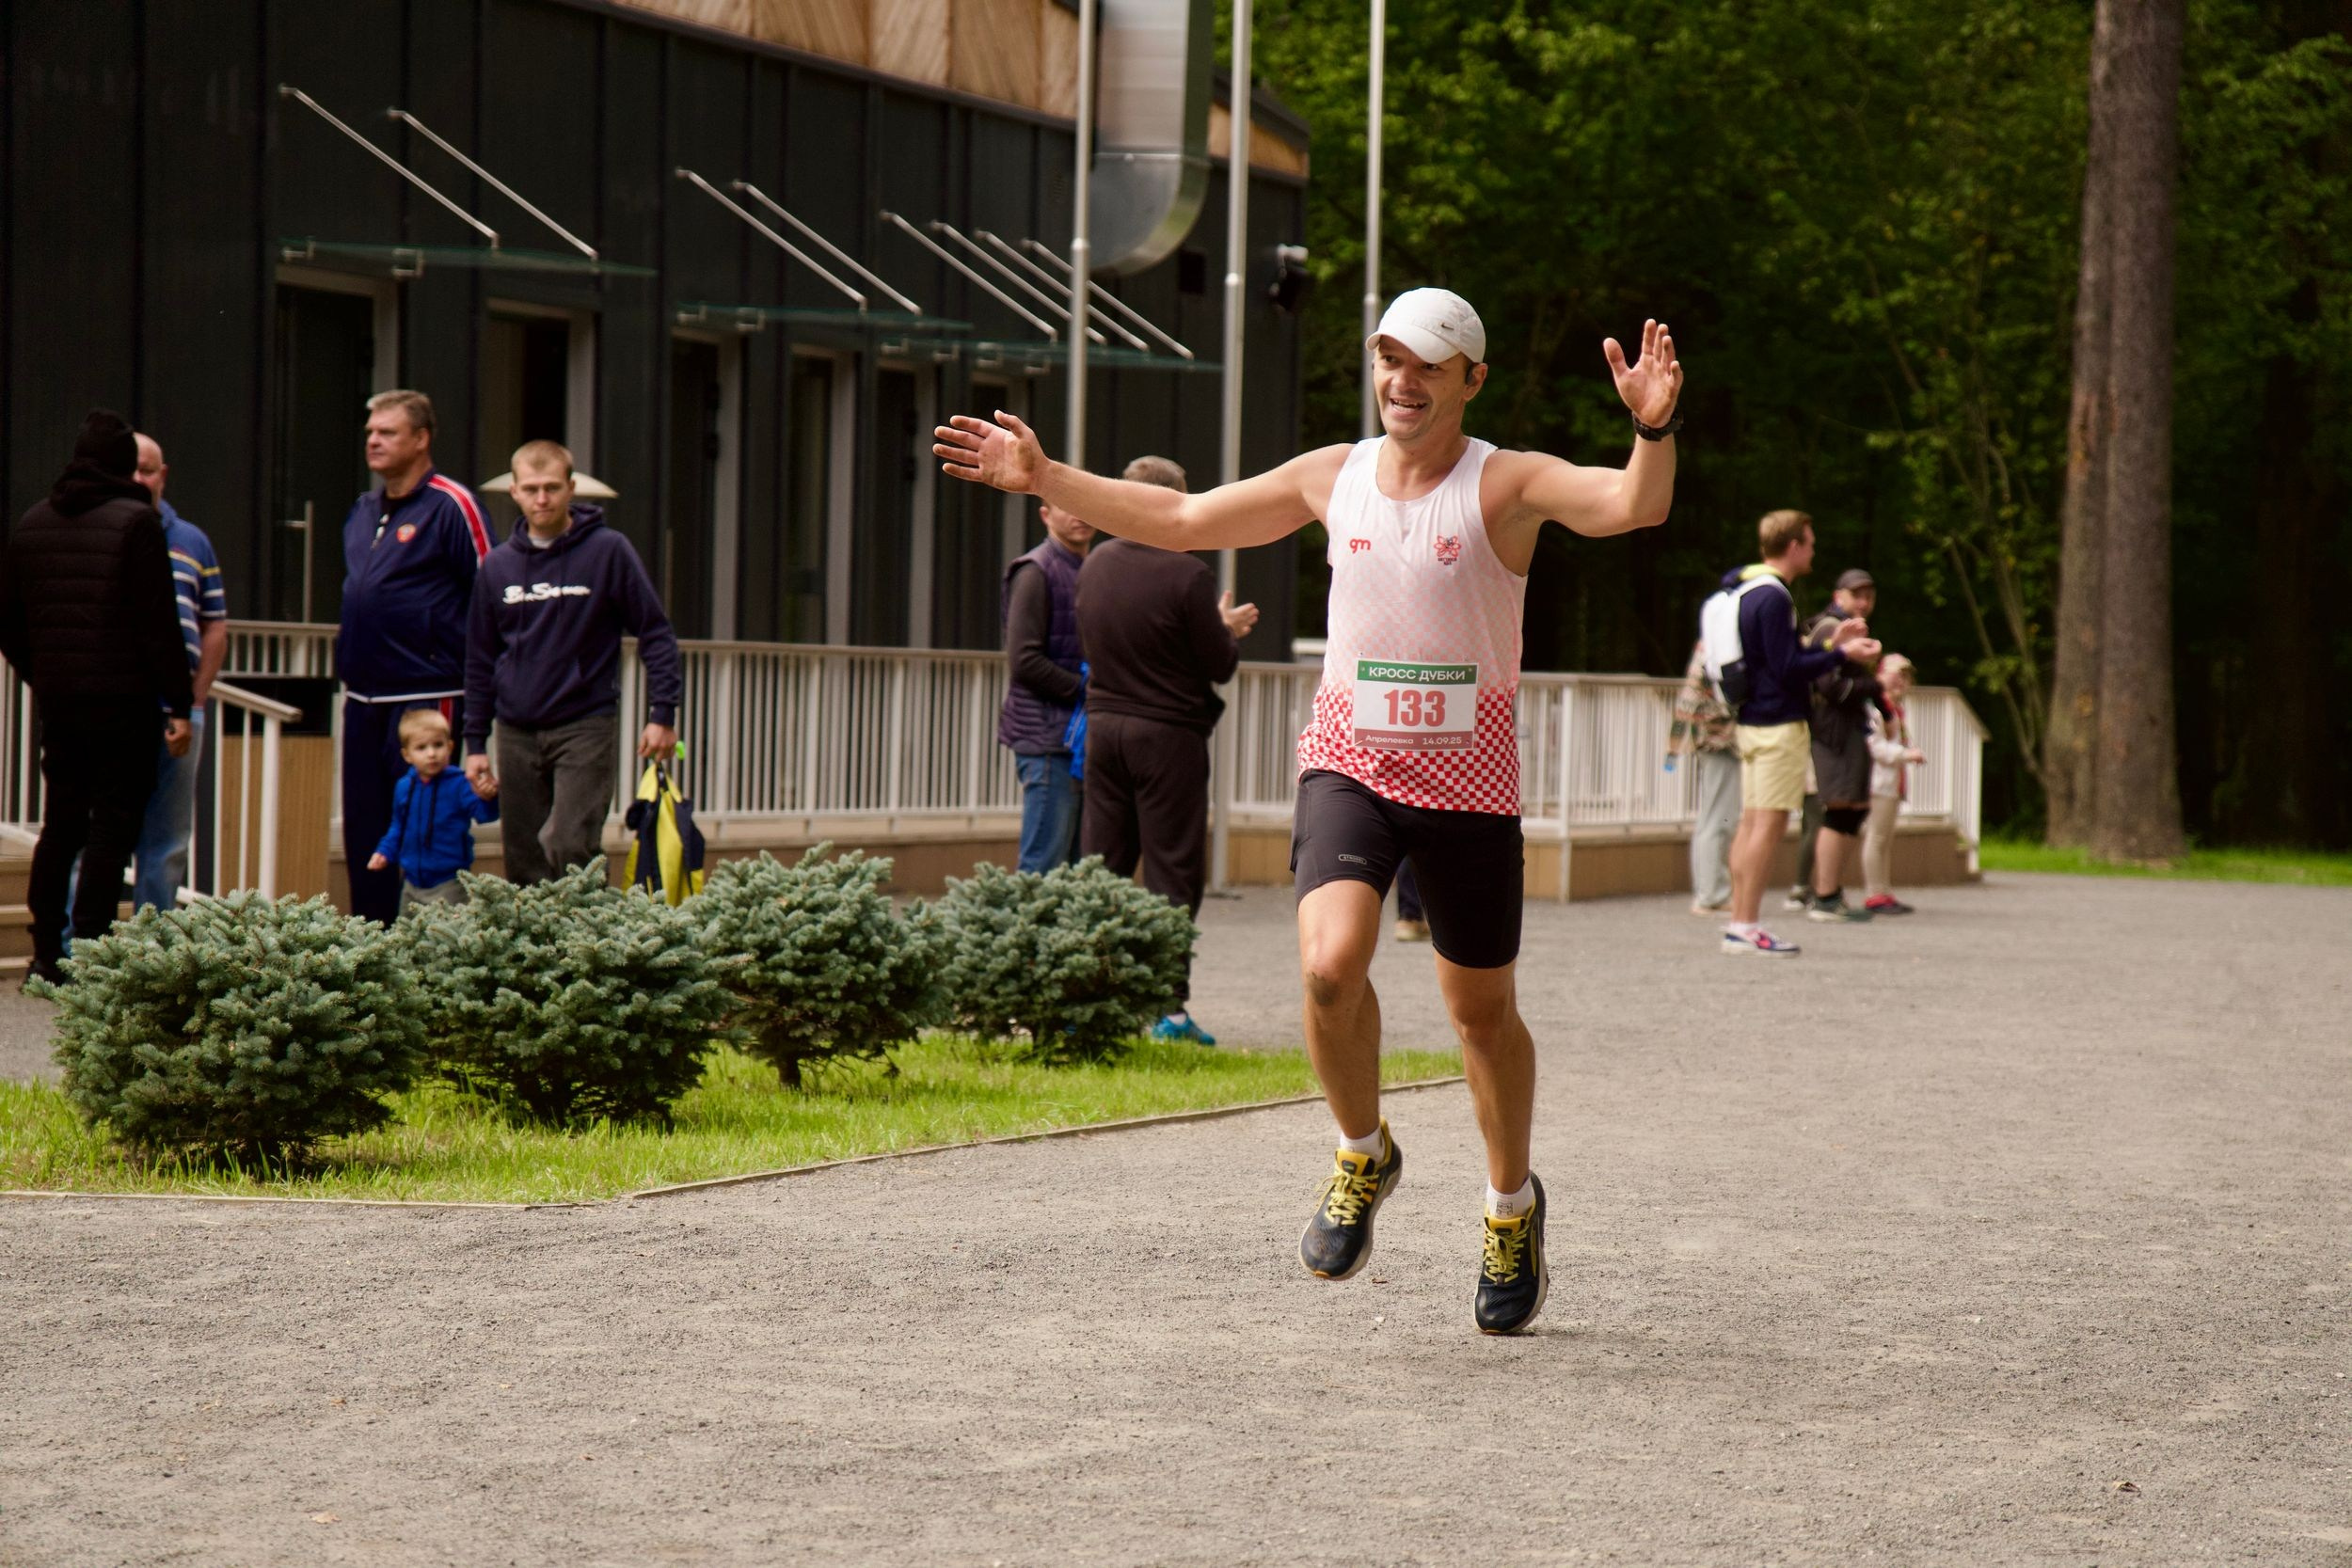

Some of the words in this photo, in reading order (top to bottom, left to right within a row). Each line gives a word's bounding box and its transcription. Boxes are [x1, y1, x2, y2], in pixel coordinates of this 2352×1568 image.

[1369, 666, 1417, 680] КРОСС
[1419, 669, 1466, 682] ДУБКИ
[1384, 689, 1446, 727] 133
[1365, 735, 1414, 745] Апрелевка
[1422, 736, 1462, 746] 14.09.25
